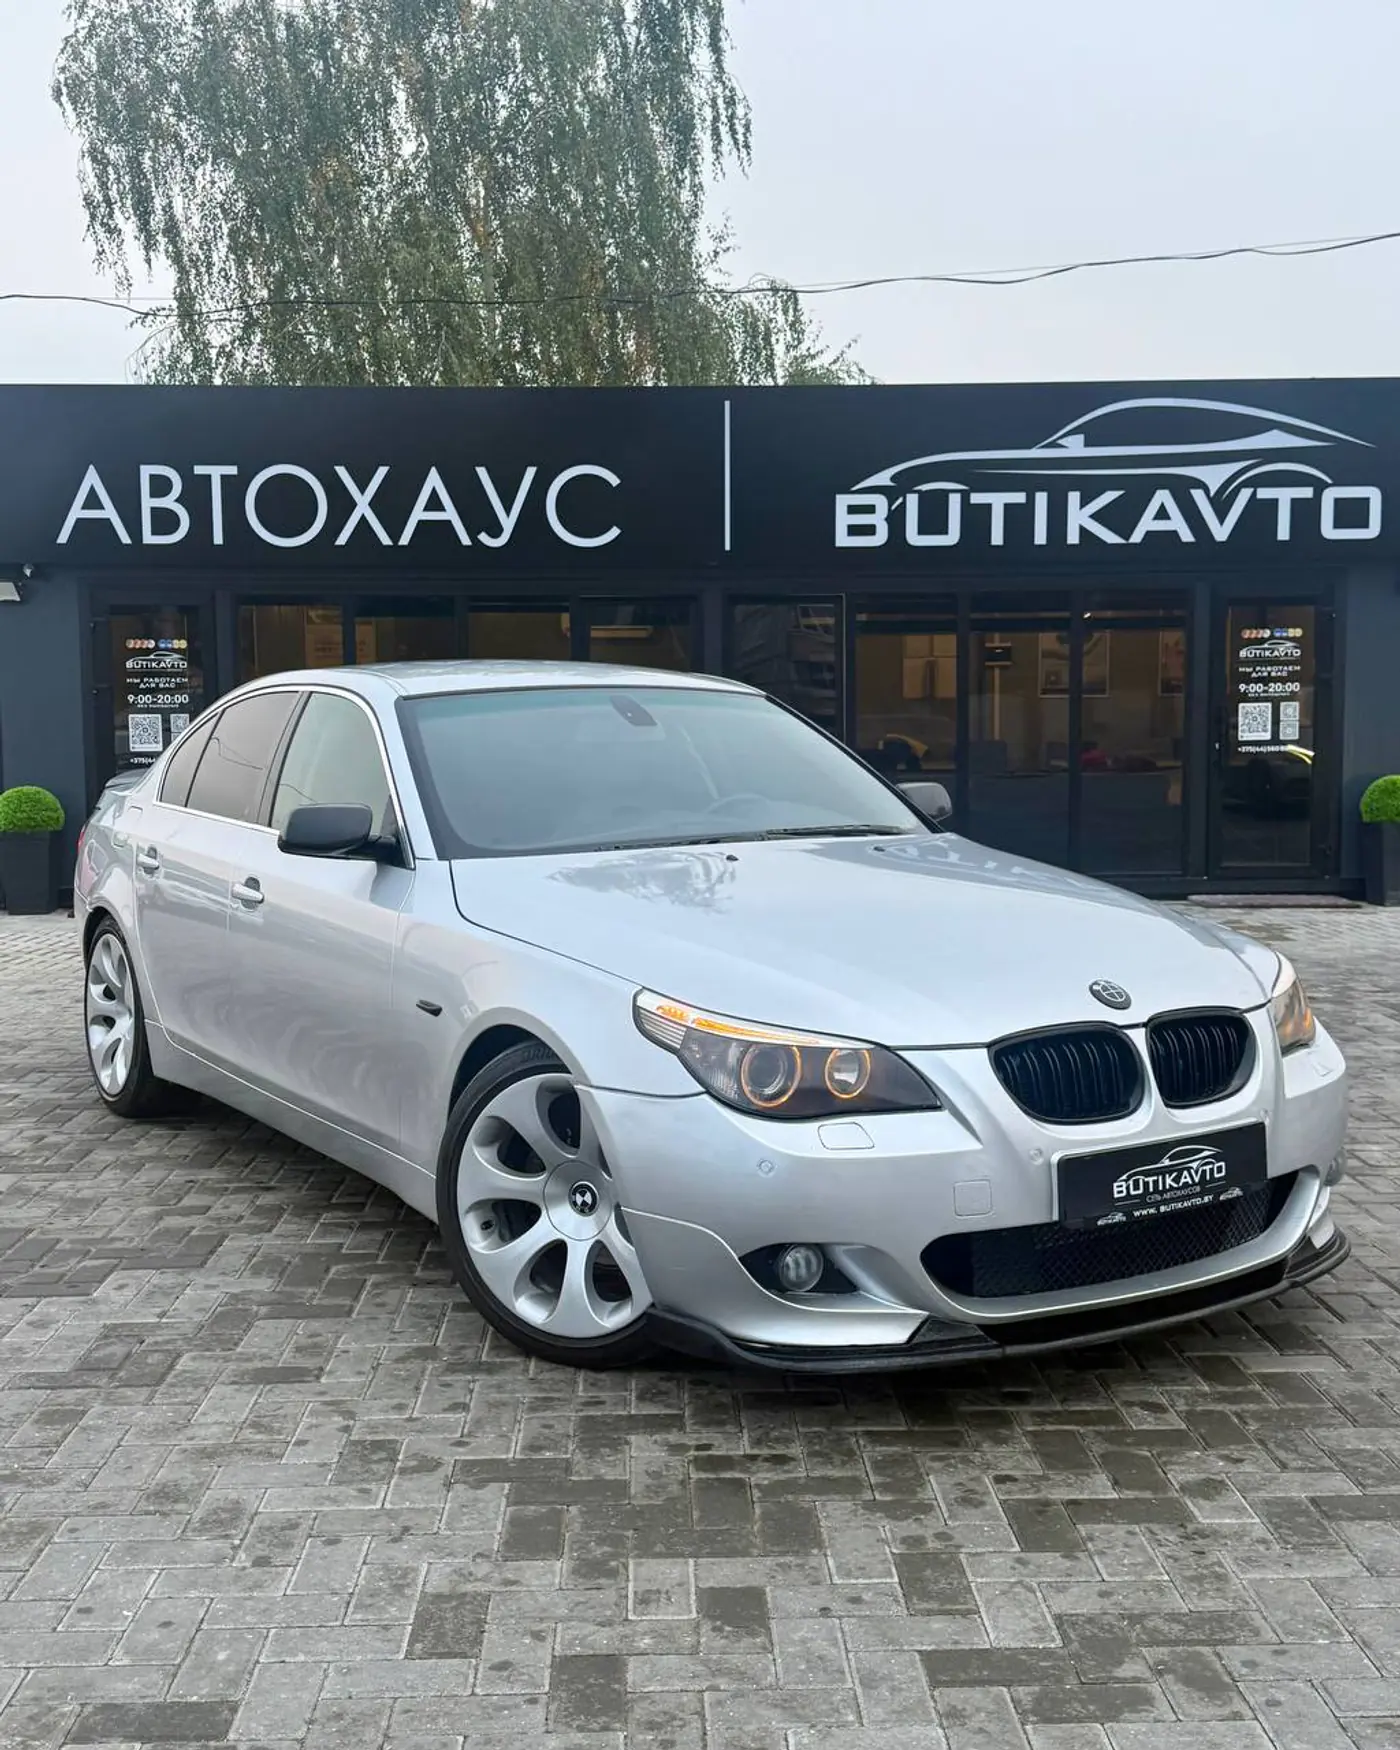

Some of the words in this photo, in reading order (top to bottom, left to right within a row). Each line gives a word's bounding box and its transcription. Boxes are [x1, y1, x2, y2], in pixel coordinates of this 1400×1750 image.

[56, 464, 622, 548] АВТОХАУС
[835, 486, 1382, 548] BUTIKAVTO
[1239, 648, 1302, 658] BUTIKAVTO
[125, 660, 188, 669] BUTIKAVTO
[1238, 682, 1301, 693] 9:00-20:00
[127, 694, 189, 704] 9:00-20:00
[1112, 1161, 1226, 1198] BUTIKAVTO
[1159, 1194, 1215, 1213] BUTIKAVTO.BY
